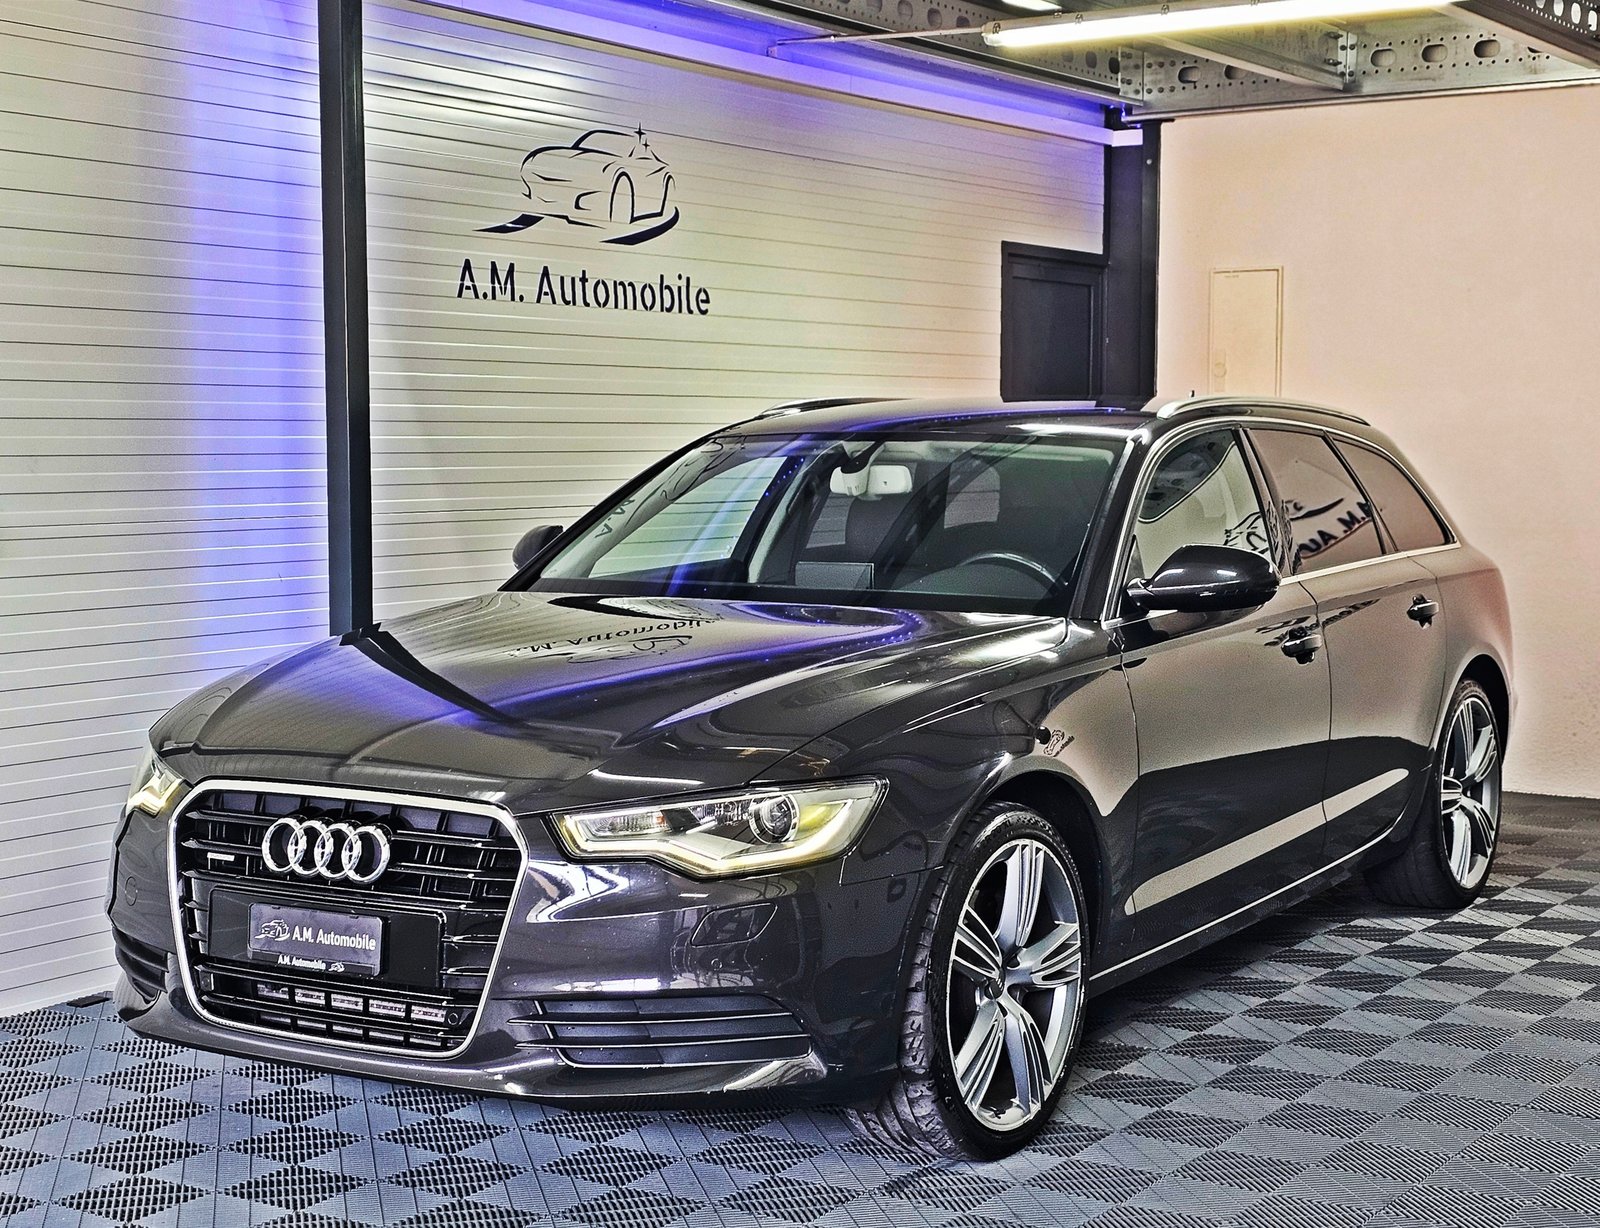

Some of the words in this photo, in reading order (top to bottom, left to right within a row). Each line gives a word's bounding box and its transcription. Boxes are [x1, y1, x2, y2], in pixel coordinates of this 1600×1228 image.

[457, 258, 524, 303] A.M.
[536, 265, 711, 316] Automobile
[292, 925, 315, 943] A.M.
[316, 928, 376, 951] Automobile
[292, 955, 327, 971] Automobile
